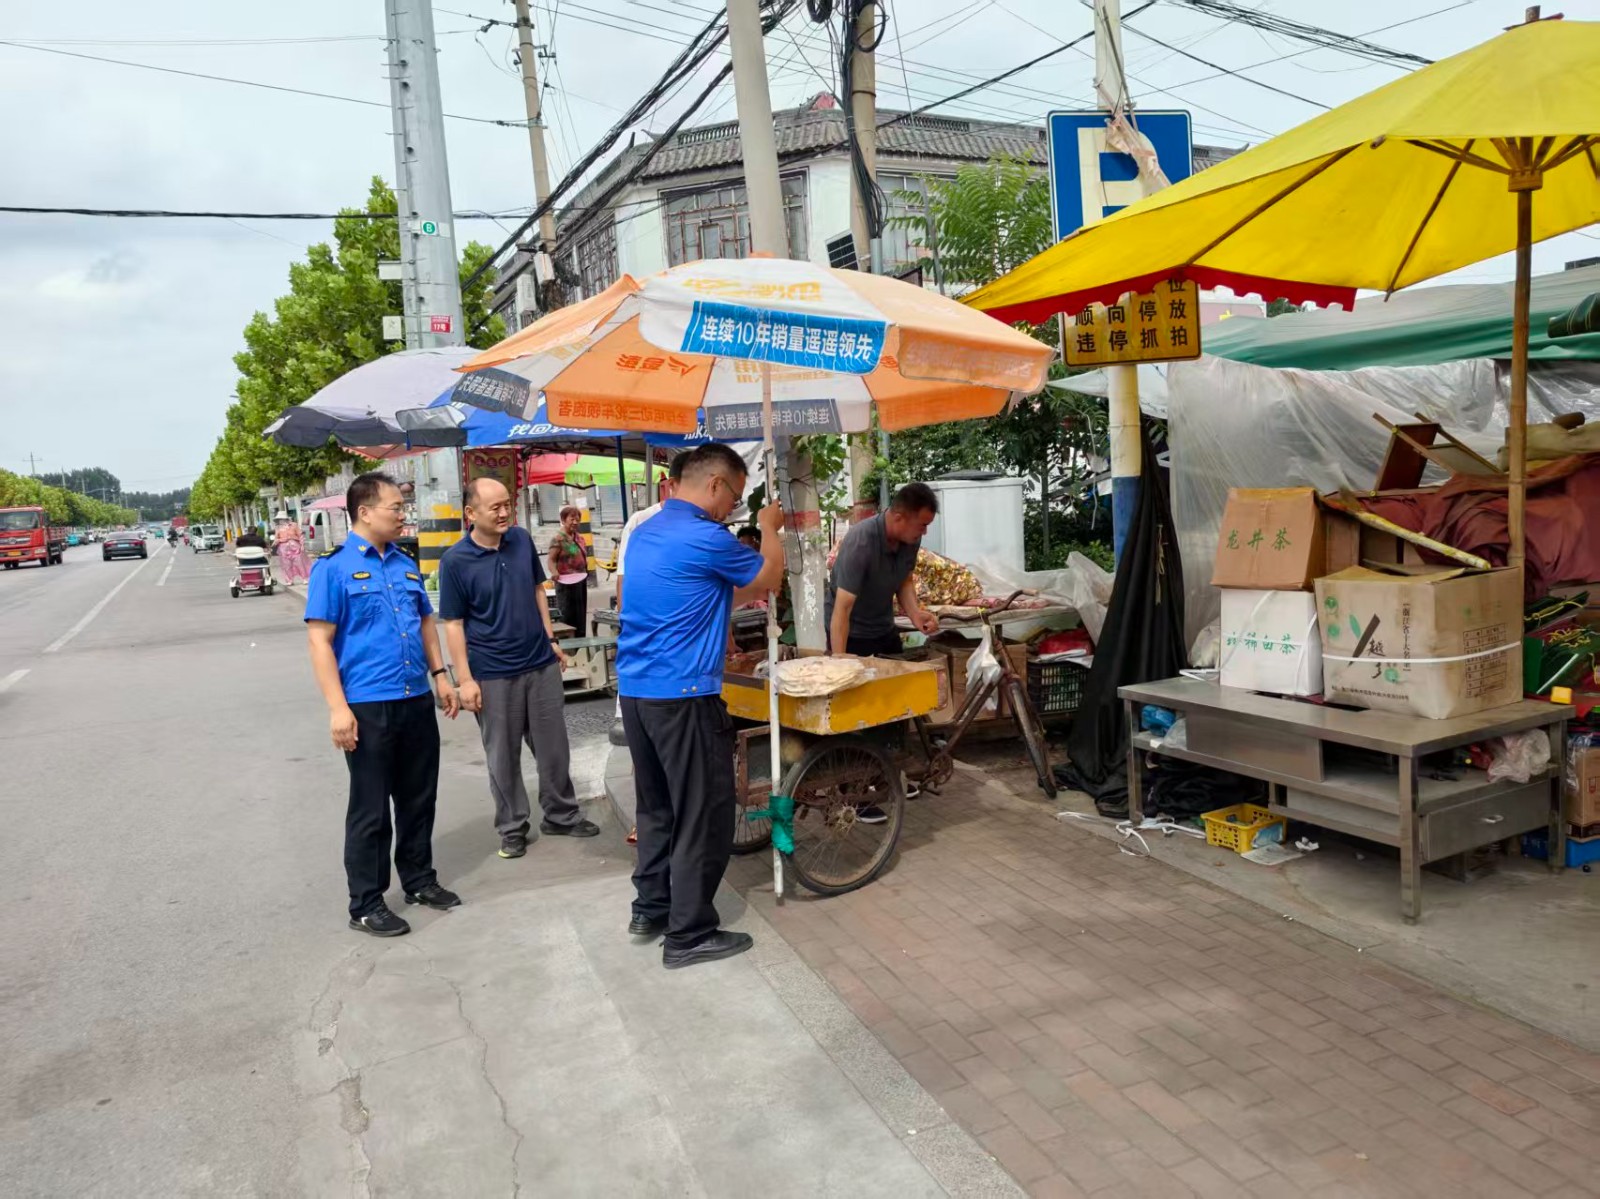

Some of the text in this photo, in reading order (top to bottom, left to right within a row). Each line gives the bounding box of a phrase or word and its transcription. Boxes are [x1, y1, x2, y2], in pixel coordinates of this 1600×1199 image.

[1077, 127, 1158, 228] P
[1075, 299, 1187, 326] 顺向停放
[700, 315, 874, 361] 连续10年销量遥遥领先
[1076, 326, 1188, 354] 违停抓拍
